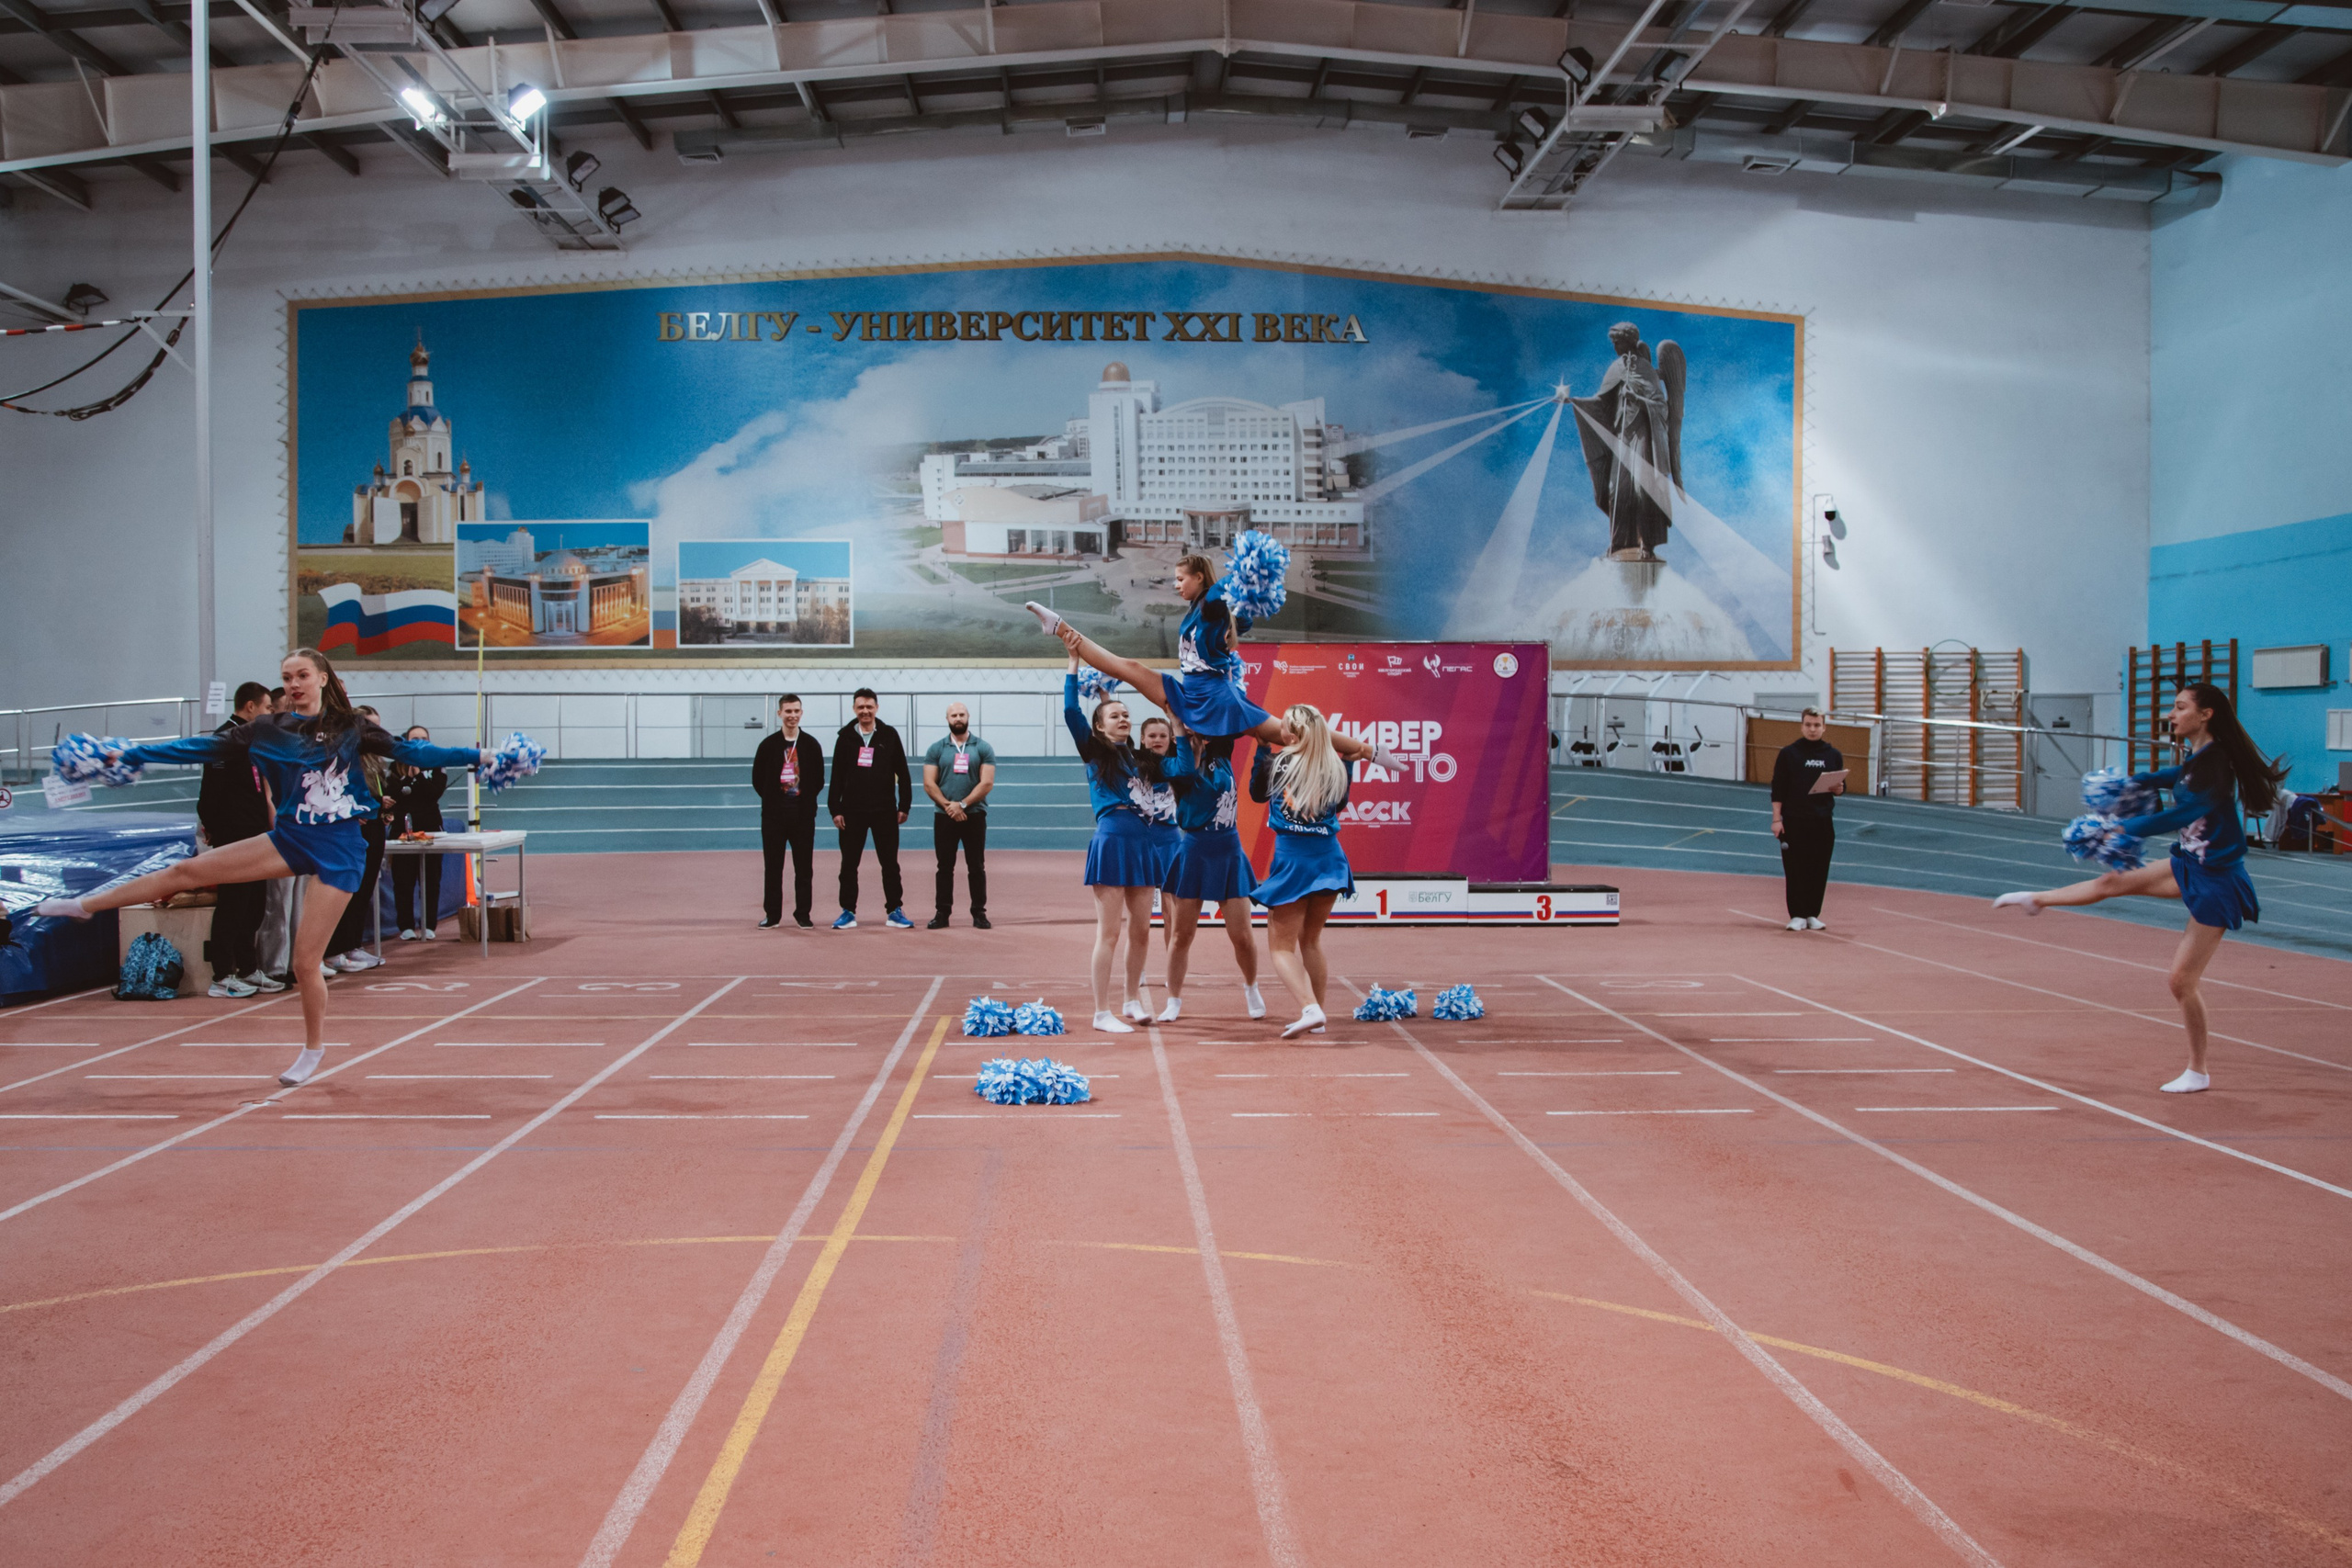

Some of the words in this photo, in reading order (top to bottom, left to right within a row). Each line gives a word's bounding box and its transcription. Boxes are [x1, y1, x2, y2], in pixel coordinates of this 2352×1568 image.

[656, 311, 799, 342] БЕЛГУ
[831, 310, 1155, 343] УНИВЕРСИТЕТ
[1253, 313, 1370, 344] ВЕКА
[1338, 662, 1364, 671] СВОИ
[1352, 752, 1458, 783] АГТО
[1339, 800, 1411, 821] АССК
[1375, 889, 1387, 915] 1
[1418, 891, 1453, 903] БелГУ
[1536, 895, 1552, 921] 3
[577, 982, 682, 991] 3
